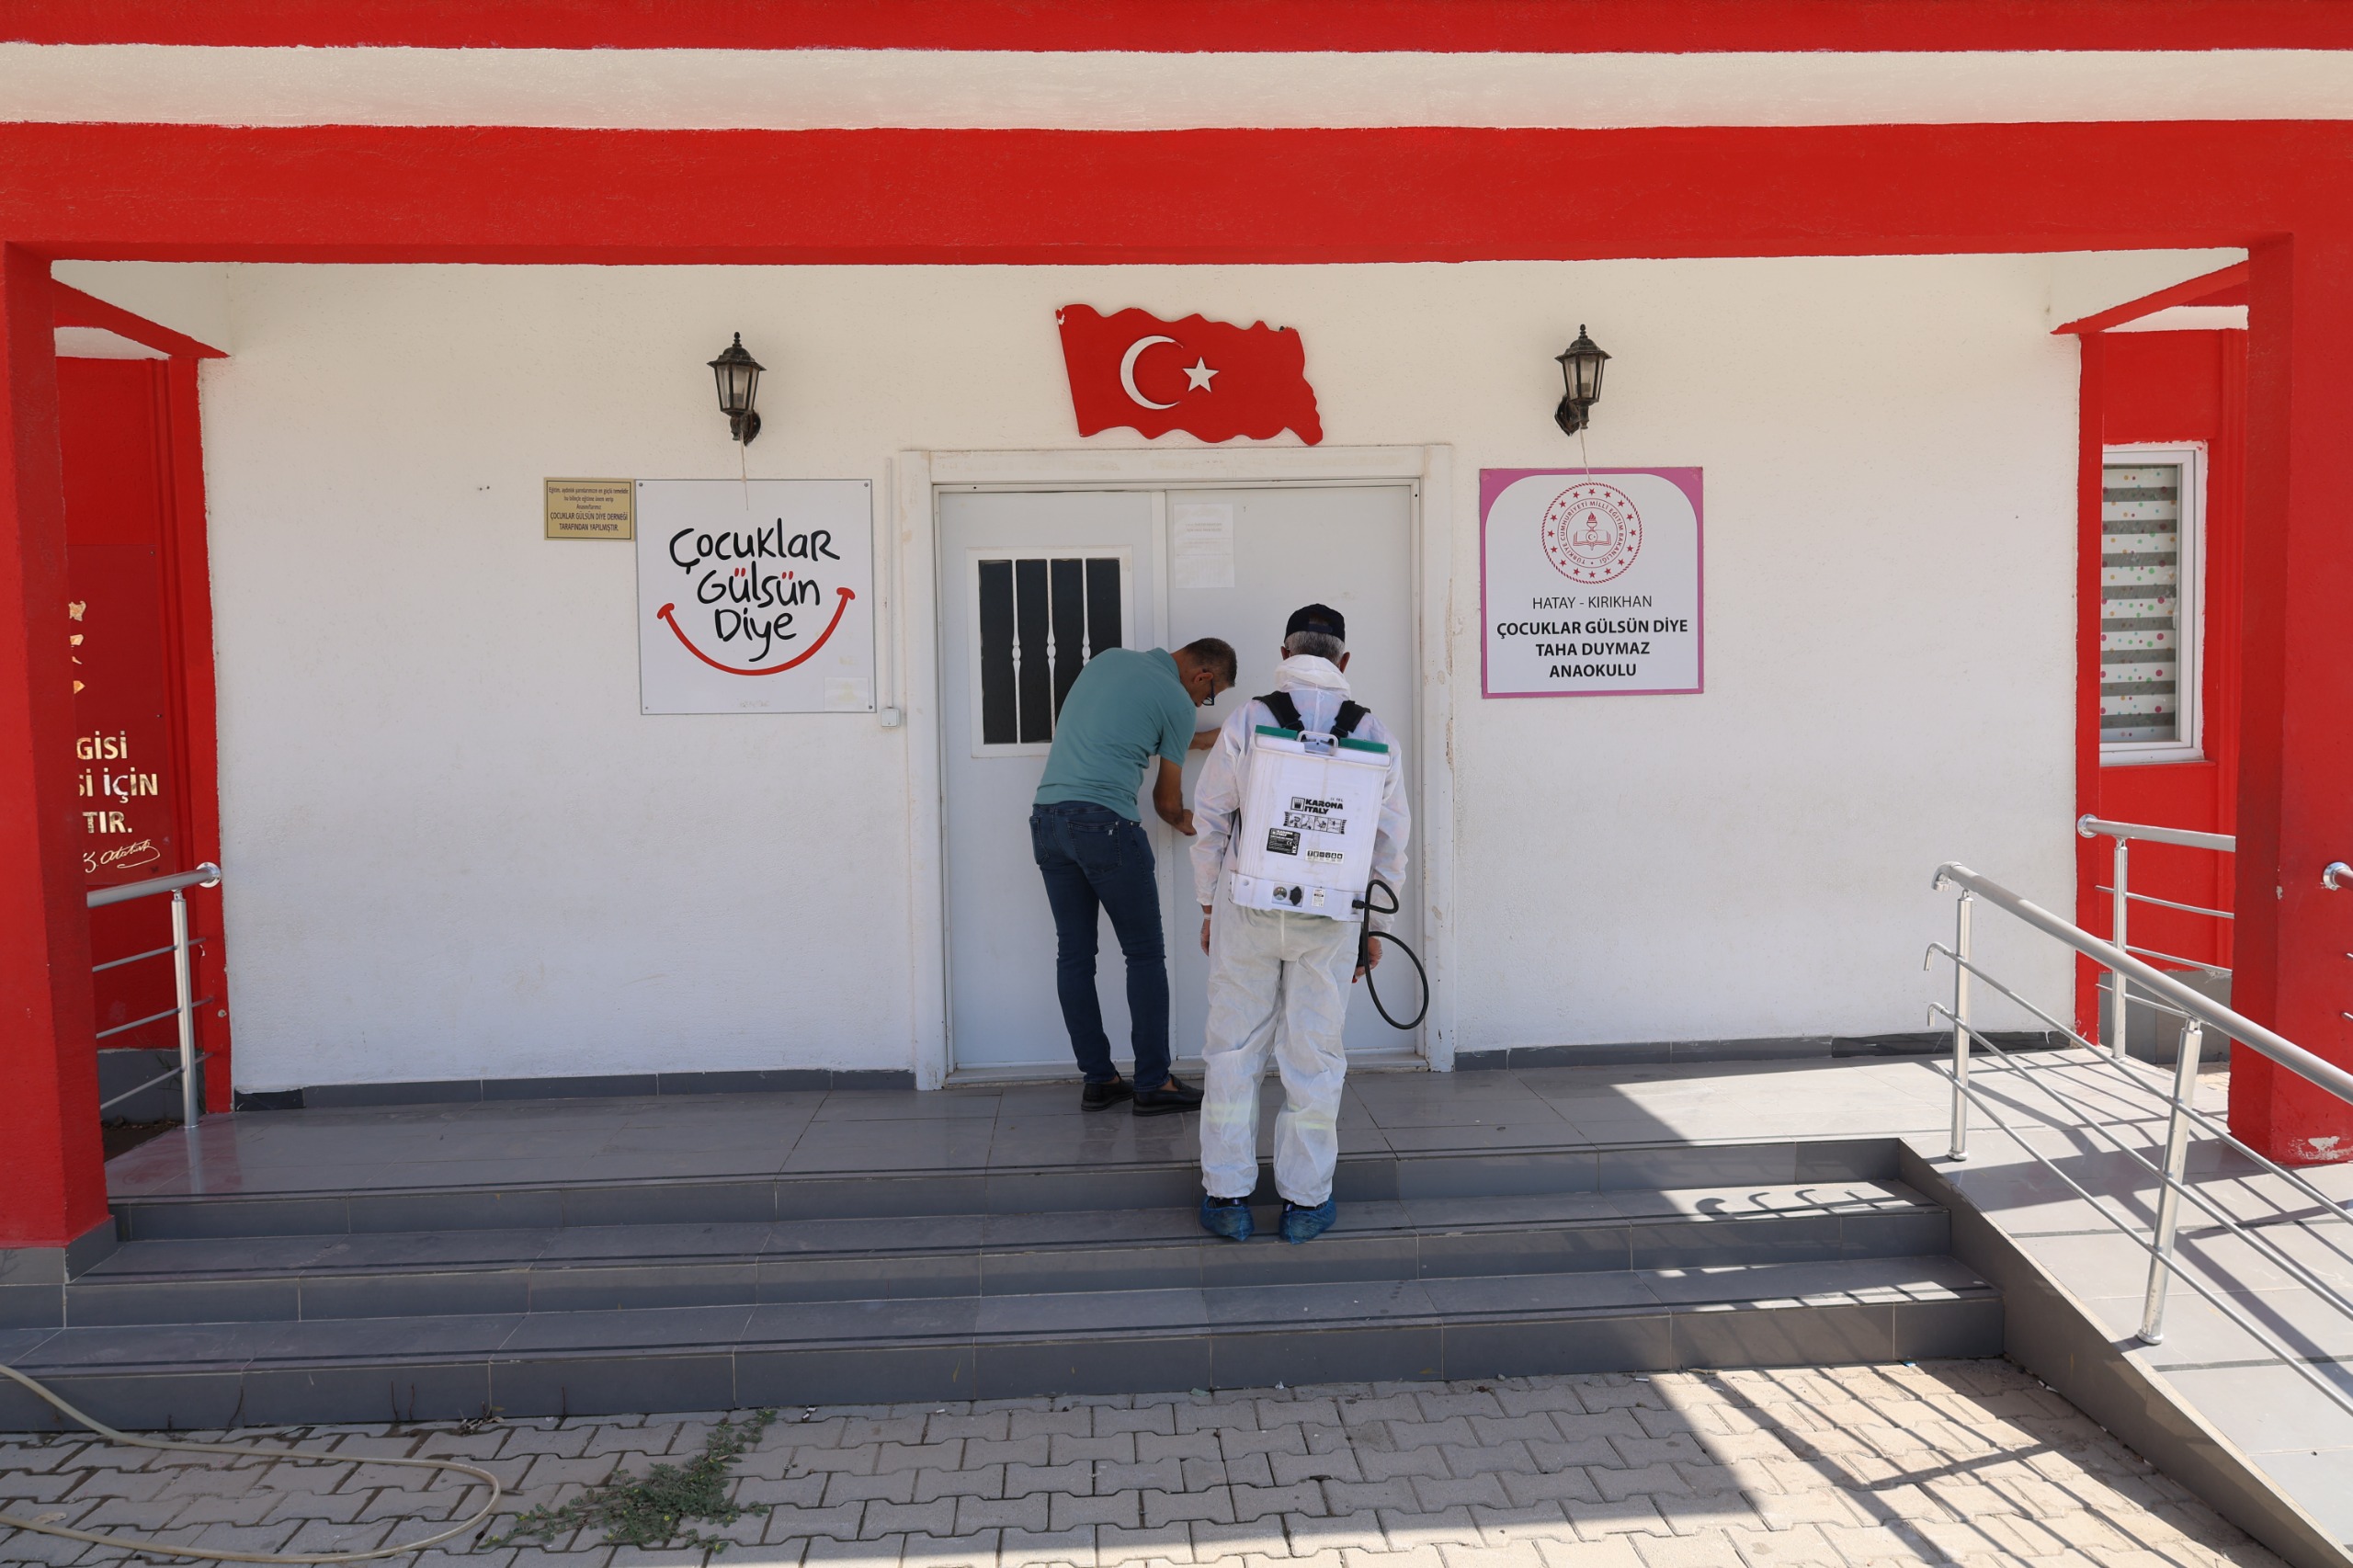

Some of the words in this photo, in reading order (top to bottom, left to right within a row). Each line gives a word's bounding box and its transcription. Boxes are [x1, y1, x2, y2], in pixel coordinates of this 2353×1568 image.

[550, 512, 574, 521] ÇOCUKLAR
[575, 510, 595, 520] GÜLSÜN
[595, 511, 607, 520] DİYE
[607, 511, 628, 521] DERNEĞİ
[559, 522, 588, 530] TARAFINDAN
[697, 561, 820, 608] Gülsün
[1532, 597, 1576, 609] HATAY
[1588, 596, 1653, 608] KIRIKHAN
[714, 607, 797, 663] Diye
[1496, 621, 1582, 639] ÇOCUKLAR
[1585, 617, 1649, 634] GÜLSÜN
[1654, 617, 1688, 633] DİYE
[1536, 643, 1577, 656] TAHA
[1582, 642, 1650, 655] DUYMAZ
[1549, 664, 1637, 678] ANAOKULU
[103, 767, 158, 803] İÇİN
[1304, 805, 1329, 814] ITALY
[1305, 799, 1344, 810] KARONA
[82, 811, 132, 834] TIR.
